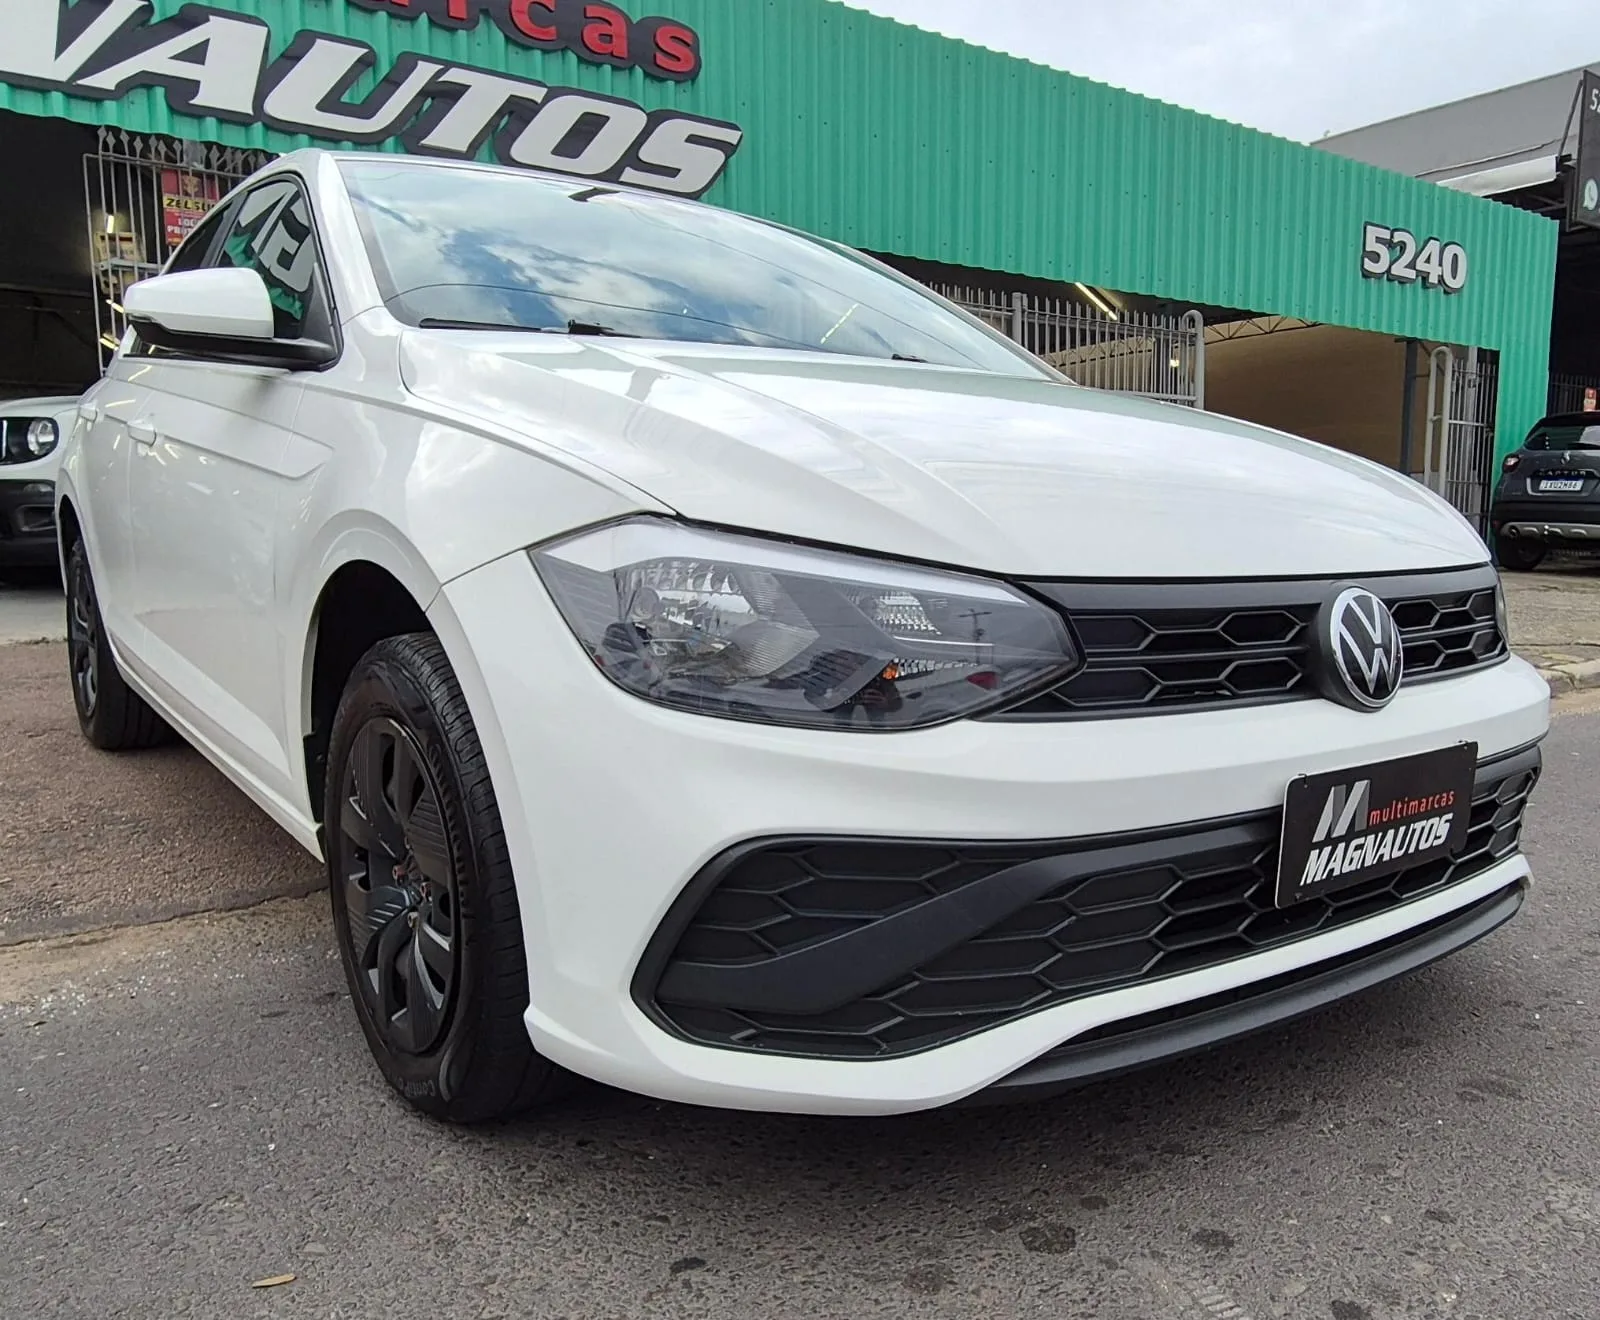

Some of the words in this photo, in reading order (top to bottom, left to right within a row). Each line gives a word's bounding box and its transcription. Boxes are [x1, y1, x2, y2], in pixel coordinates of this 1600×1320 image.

[1362, 223, 1468, 291] 5240
[1369, 790, 1455, 826] multimarcas
[1300, 813, 1454, 886] MAGNAUTOS
